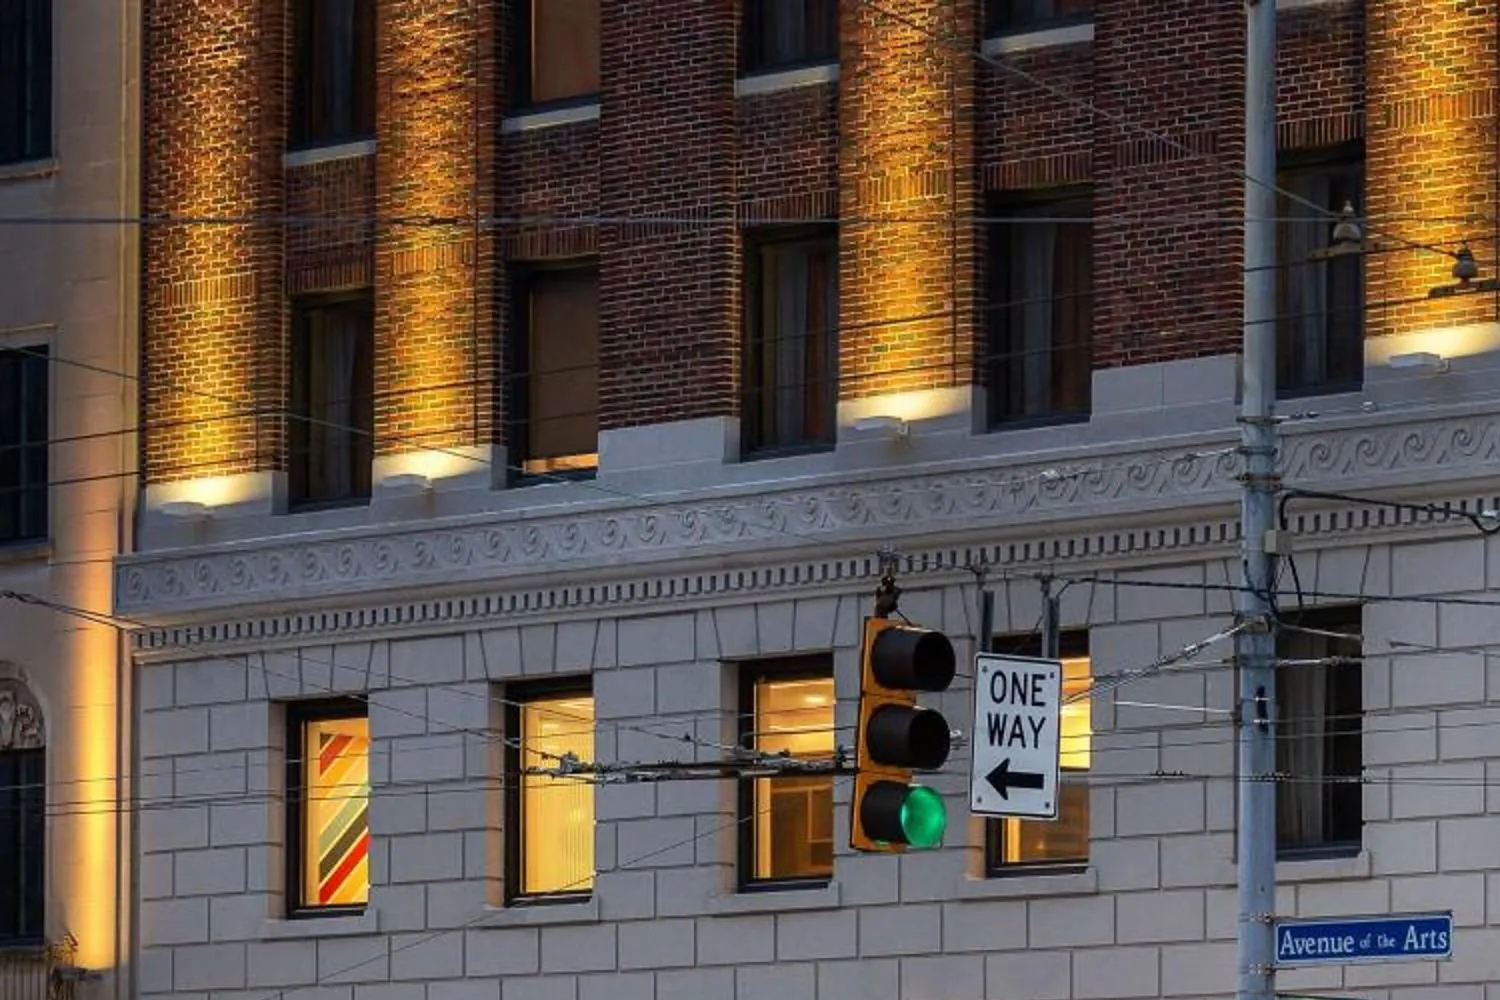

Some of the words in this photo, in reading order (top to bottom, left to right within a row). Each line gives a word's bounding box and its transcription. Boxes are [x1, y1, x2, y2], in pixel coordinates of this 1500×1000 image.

[990, 671, 1047, 707] ONE
[987, 712, 1047, 749] WAY
[1279, 929, 1355, 956] Avenue
[1359, 932, 1373, 949] of
[1377, 933, 1397, 949] the
[1403, 924, 1448, 951] Arts
